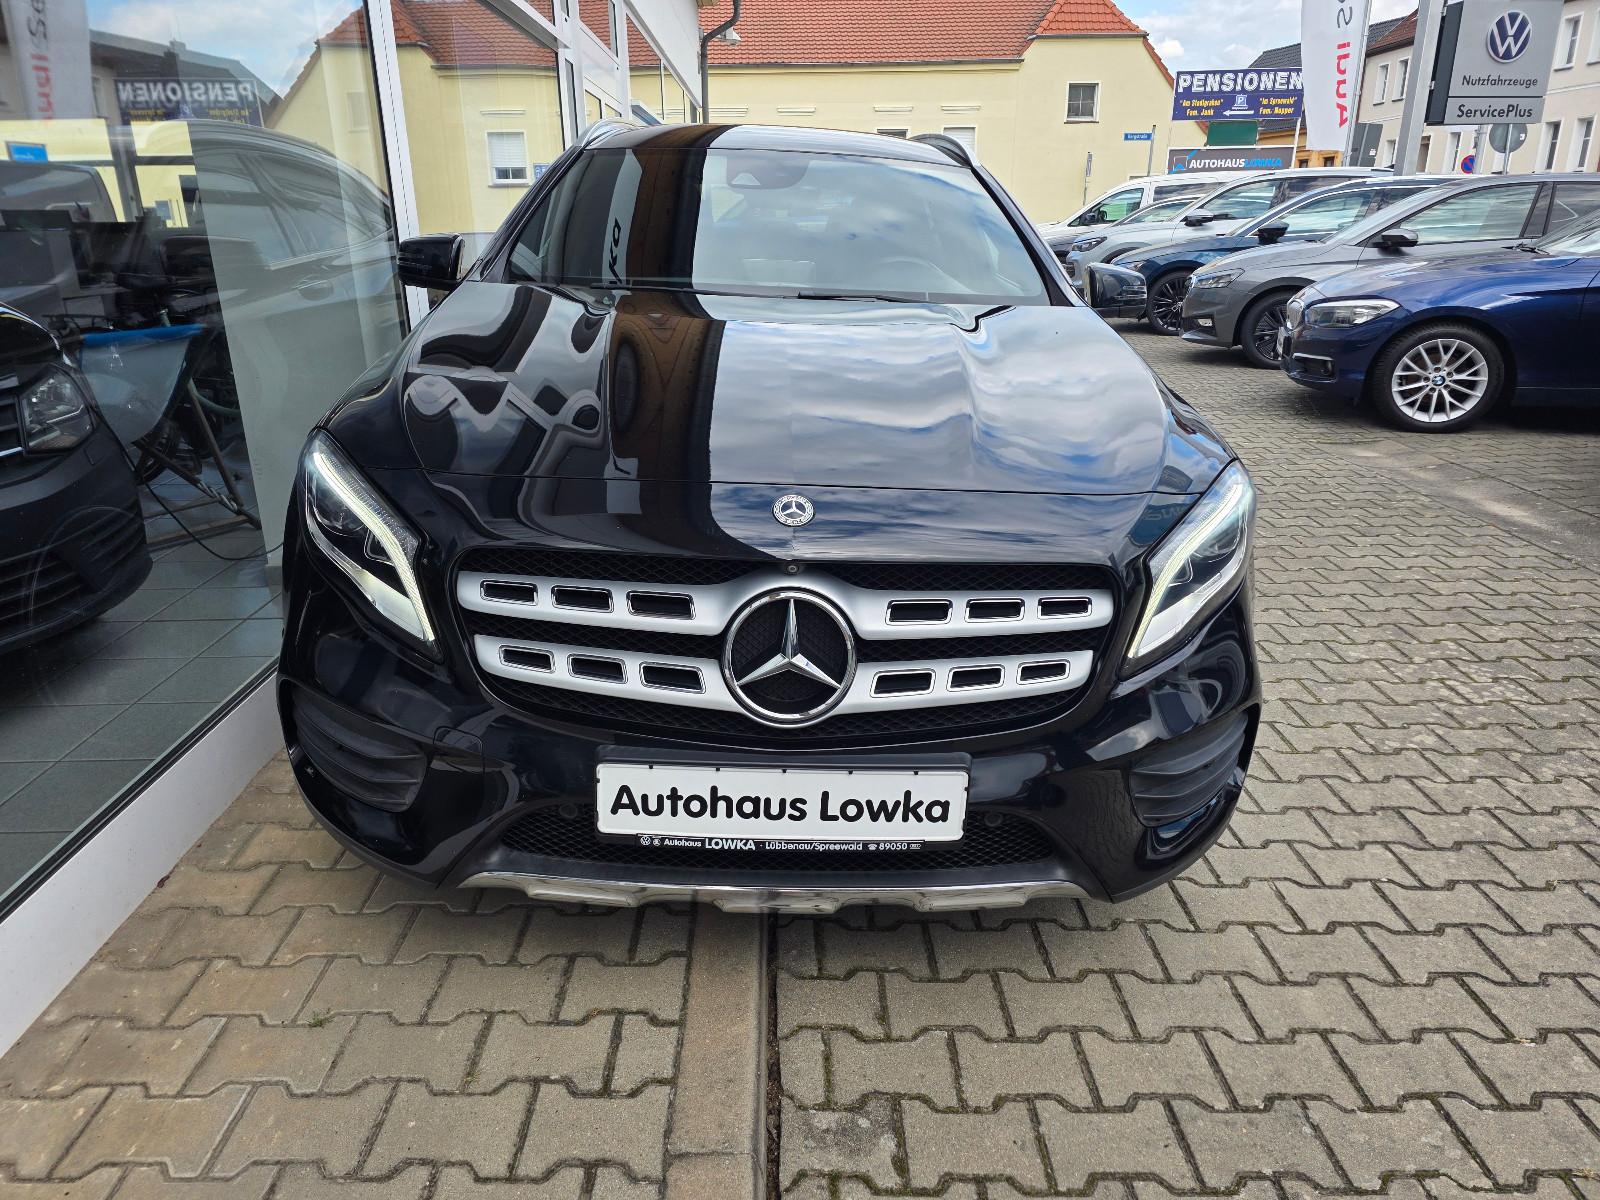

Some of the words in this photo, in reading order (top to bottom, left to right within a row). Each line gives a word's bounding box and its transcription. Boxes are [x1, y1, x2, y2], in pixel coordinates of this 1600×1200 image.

[1178, 71, 1303, 92] PENSIONEN
[1461, 75, 1538, 89] Nutzfahrzeuge
[1456, 104, 1533, 119] ServicePlus
[1188, 158, 1245, 169] AUTOHAUS
[610, 784, 808, 822] Autohaus
[819, 790, 951, 823] Lowka
[663, 838, 702, 847] Autohaus
[705, 838, 756, 850] LOWKA
[765, 841, 863, 851] Lübbenau/Spreewald
[878, 842, 908, 850] 89050
